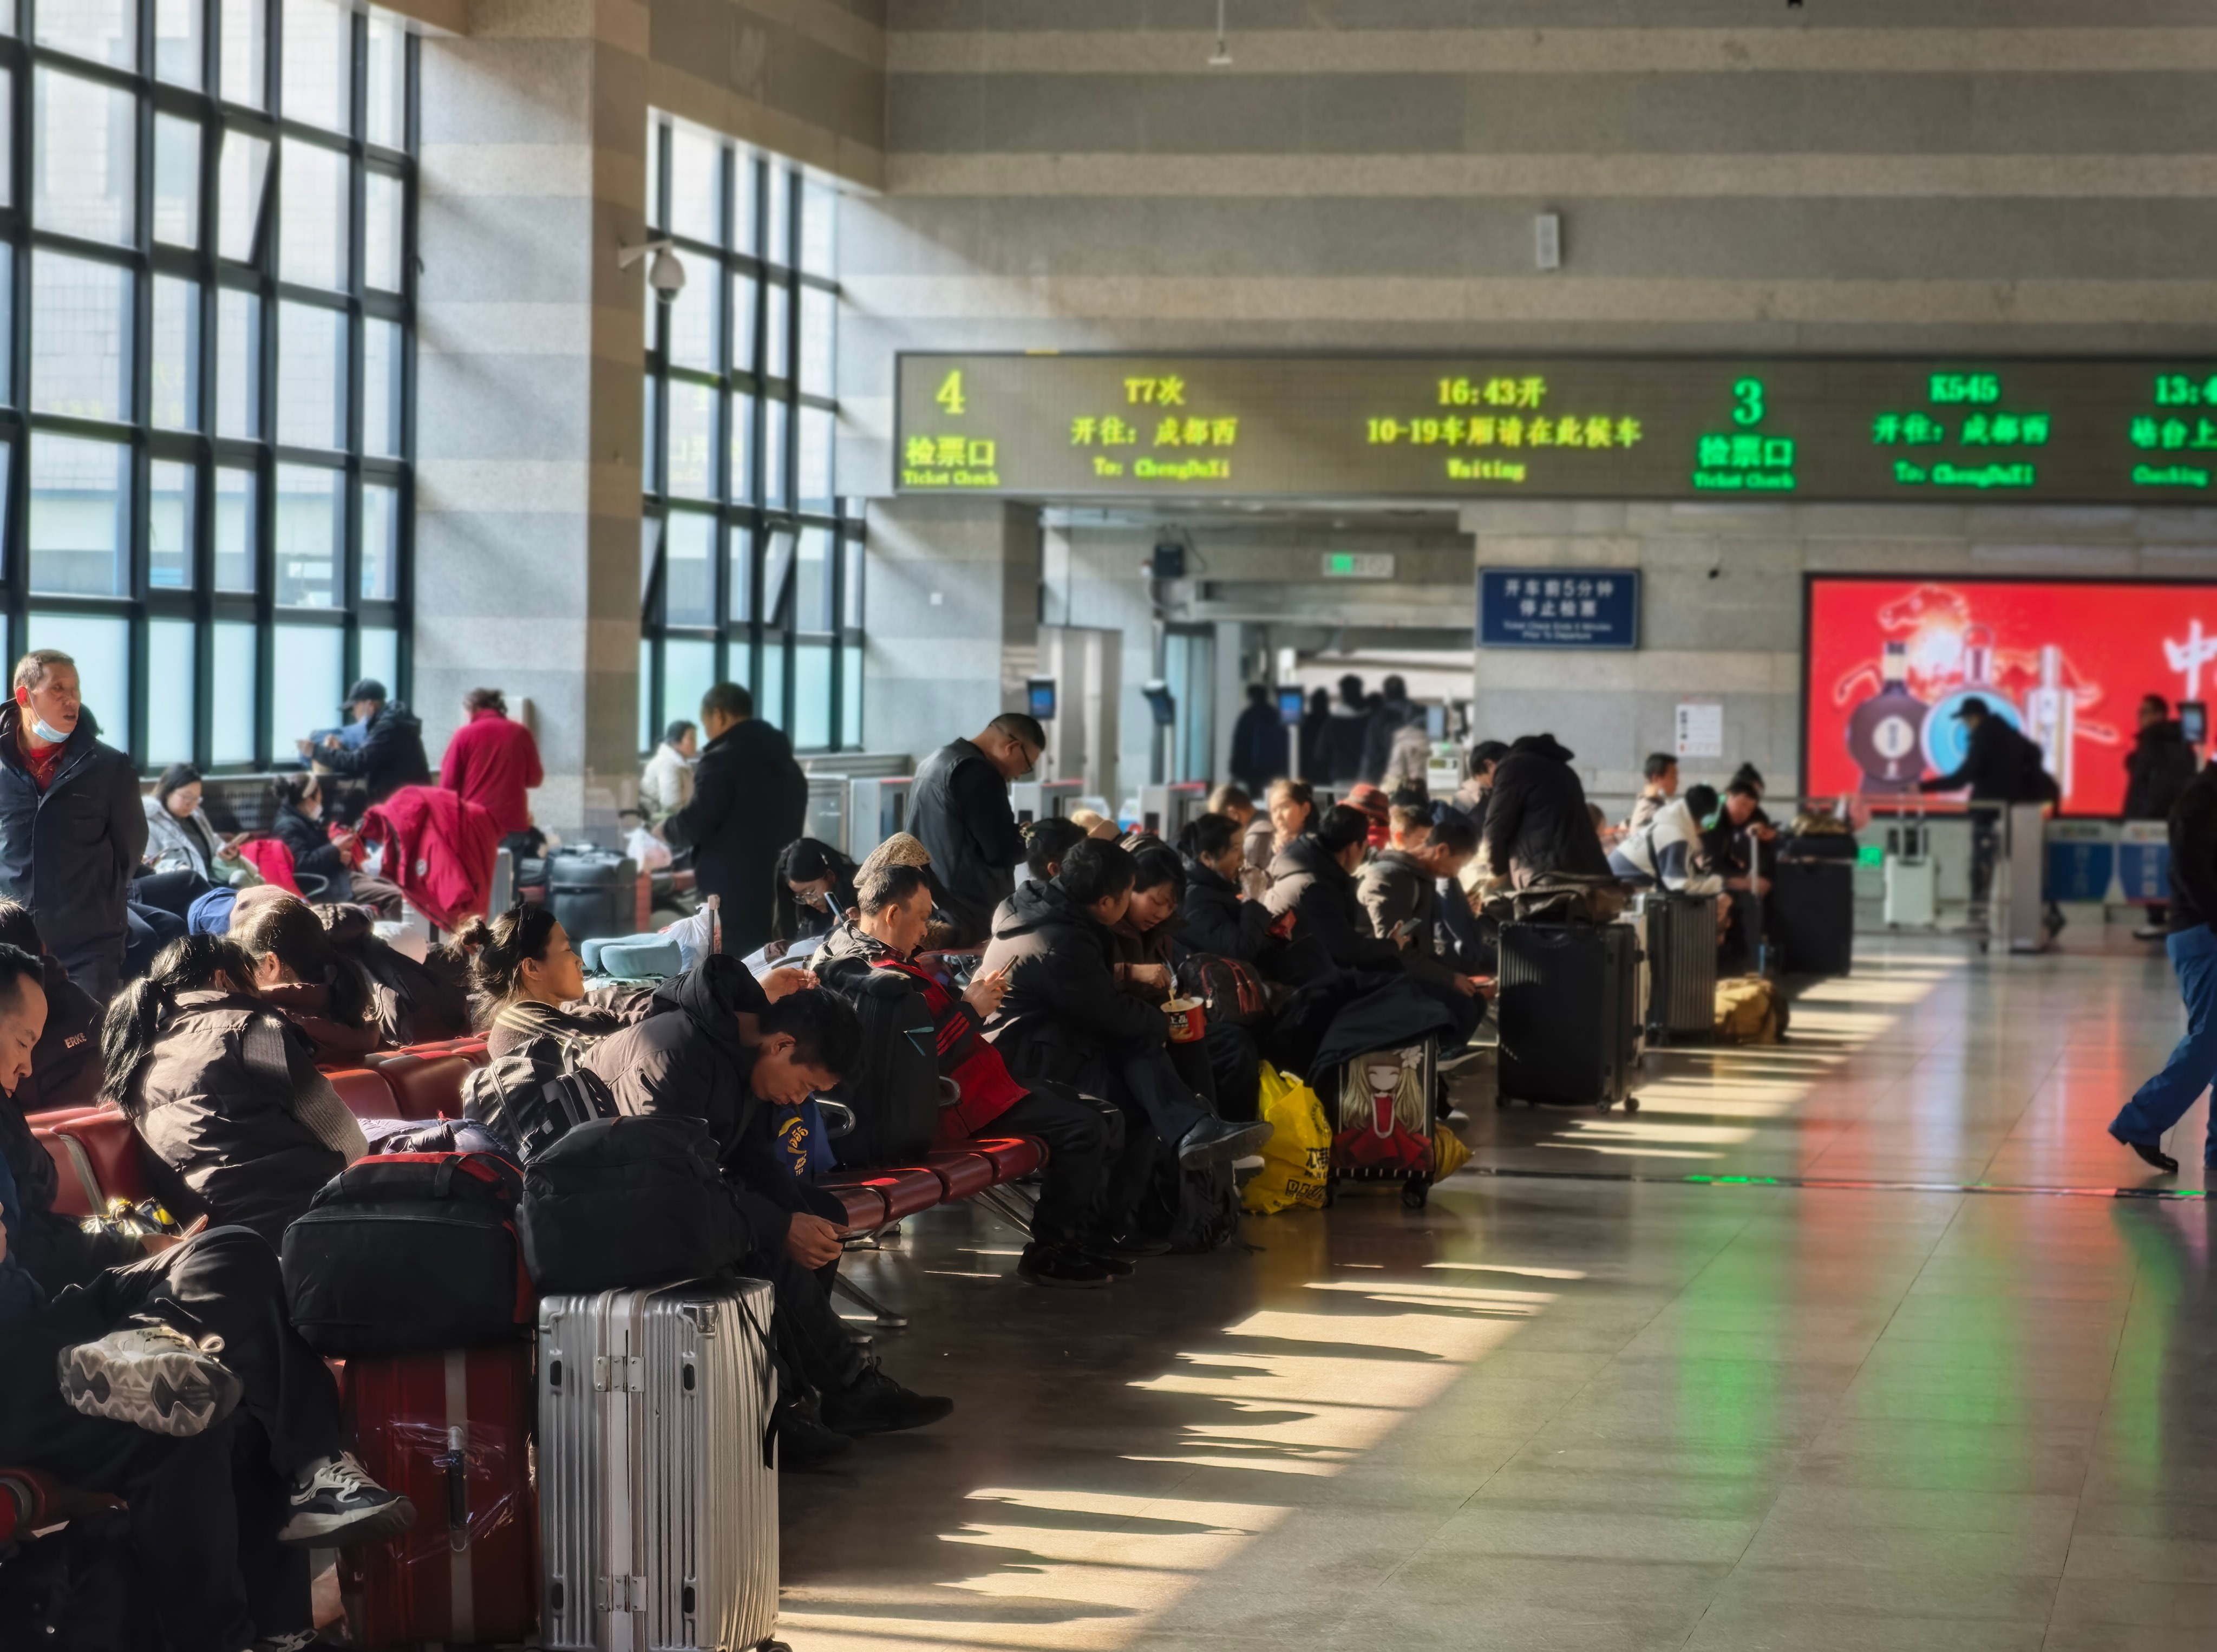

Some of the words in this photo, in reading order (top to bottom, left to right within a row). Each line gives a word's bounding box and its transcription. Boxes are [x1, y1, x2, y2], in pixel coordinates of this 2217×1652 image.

[935, 370, 966, 415] 4
[1123, 375, 1186, 406] T7次
[1437, 375, 1547, 409] 16:43开
[1733, 377, 1764, 425] 3
[1930, 375, 2000, 403] K545
[906, 436, 995, 467] 检票口
[1699, 435, 1794, 469] 检票口
[903, 469, 950, 486] Ticket
[953, 469, 999, 486] Check
[1447, 458, 1527, 482] Waiting
[1505, 579, 1614, 597] 开车前5分钟
[1520, 599, 1597, 617] 停止检票
